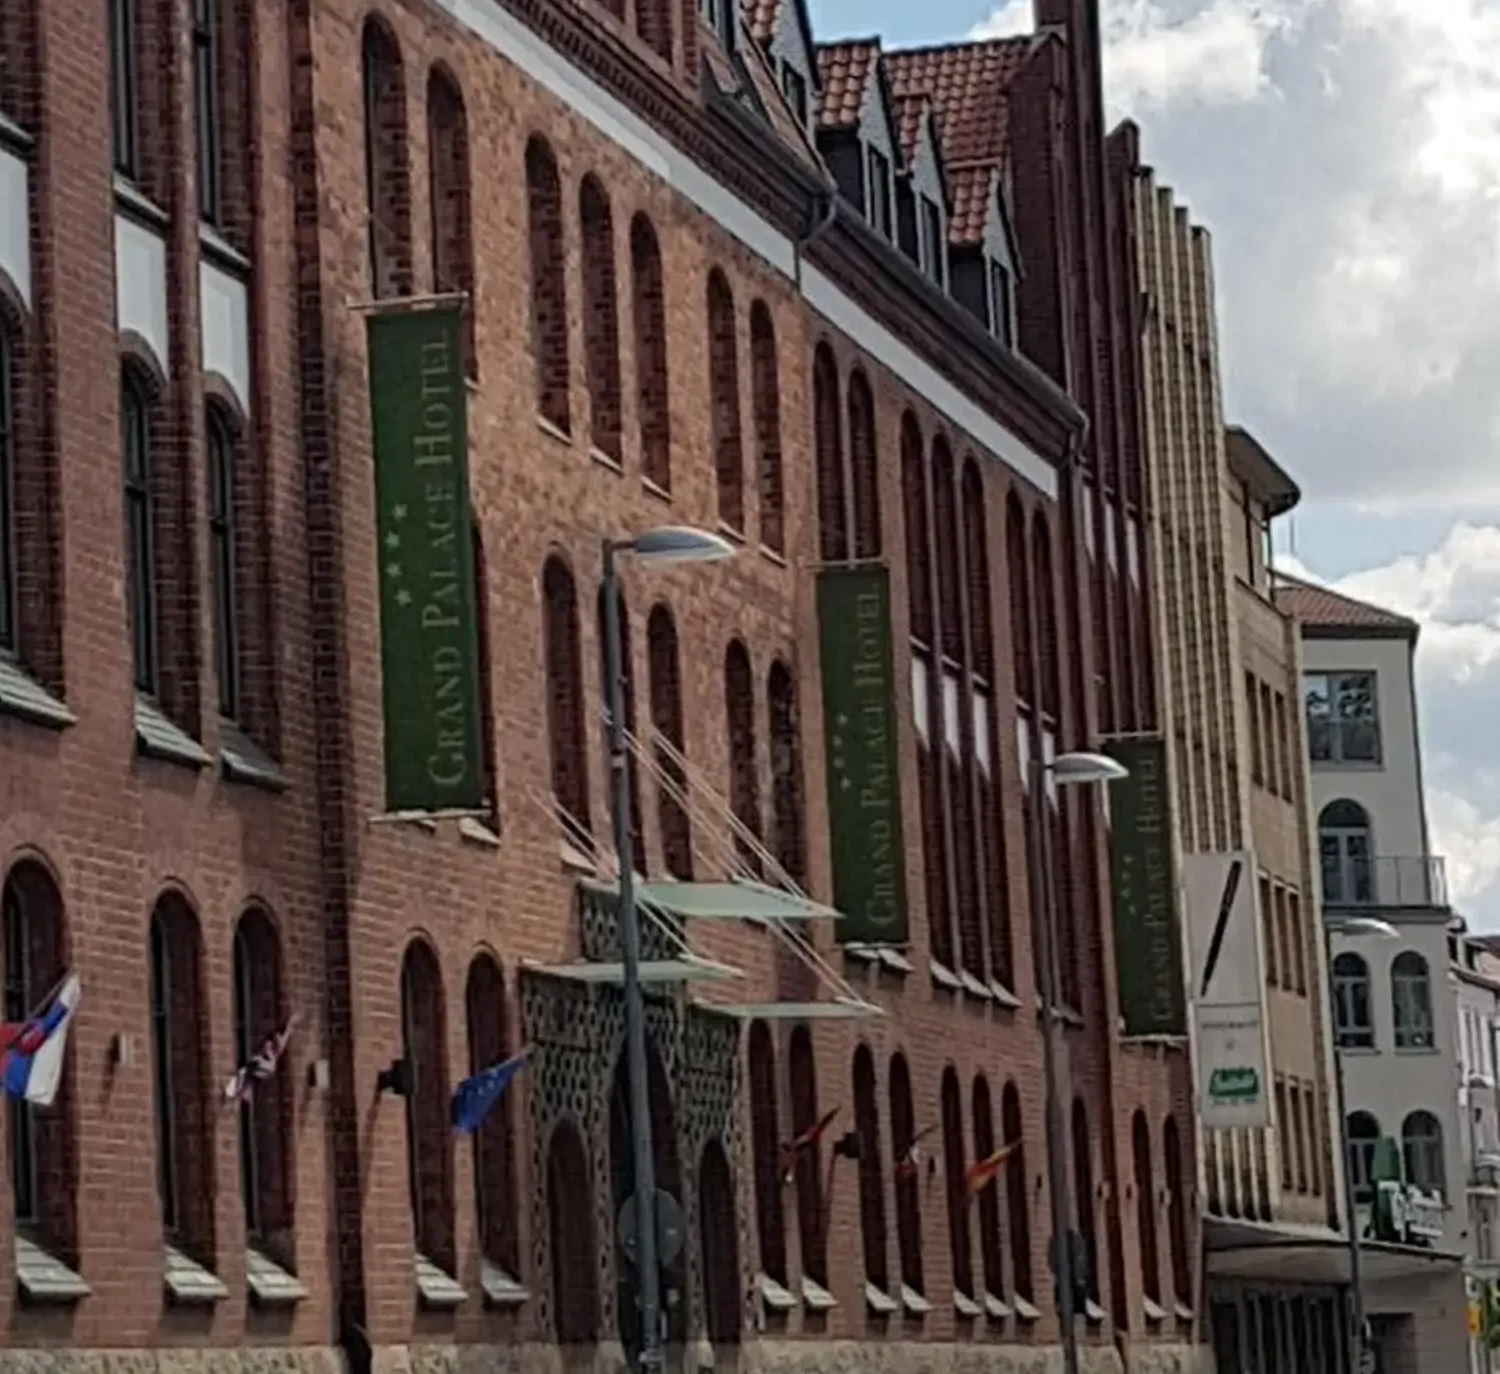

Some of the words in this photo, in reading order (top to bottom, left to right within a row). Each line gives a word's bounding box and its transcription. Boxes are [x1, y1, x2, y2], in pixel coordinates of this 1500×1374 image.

[414, 330, 452, 467] HOTEL
[422, 483, 460, 630] PALACE
[428, 647, 465, 786] GRAND
